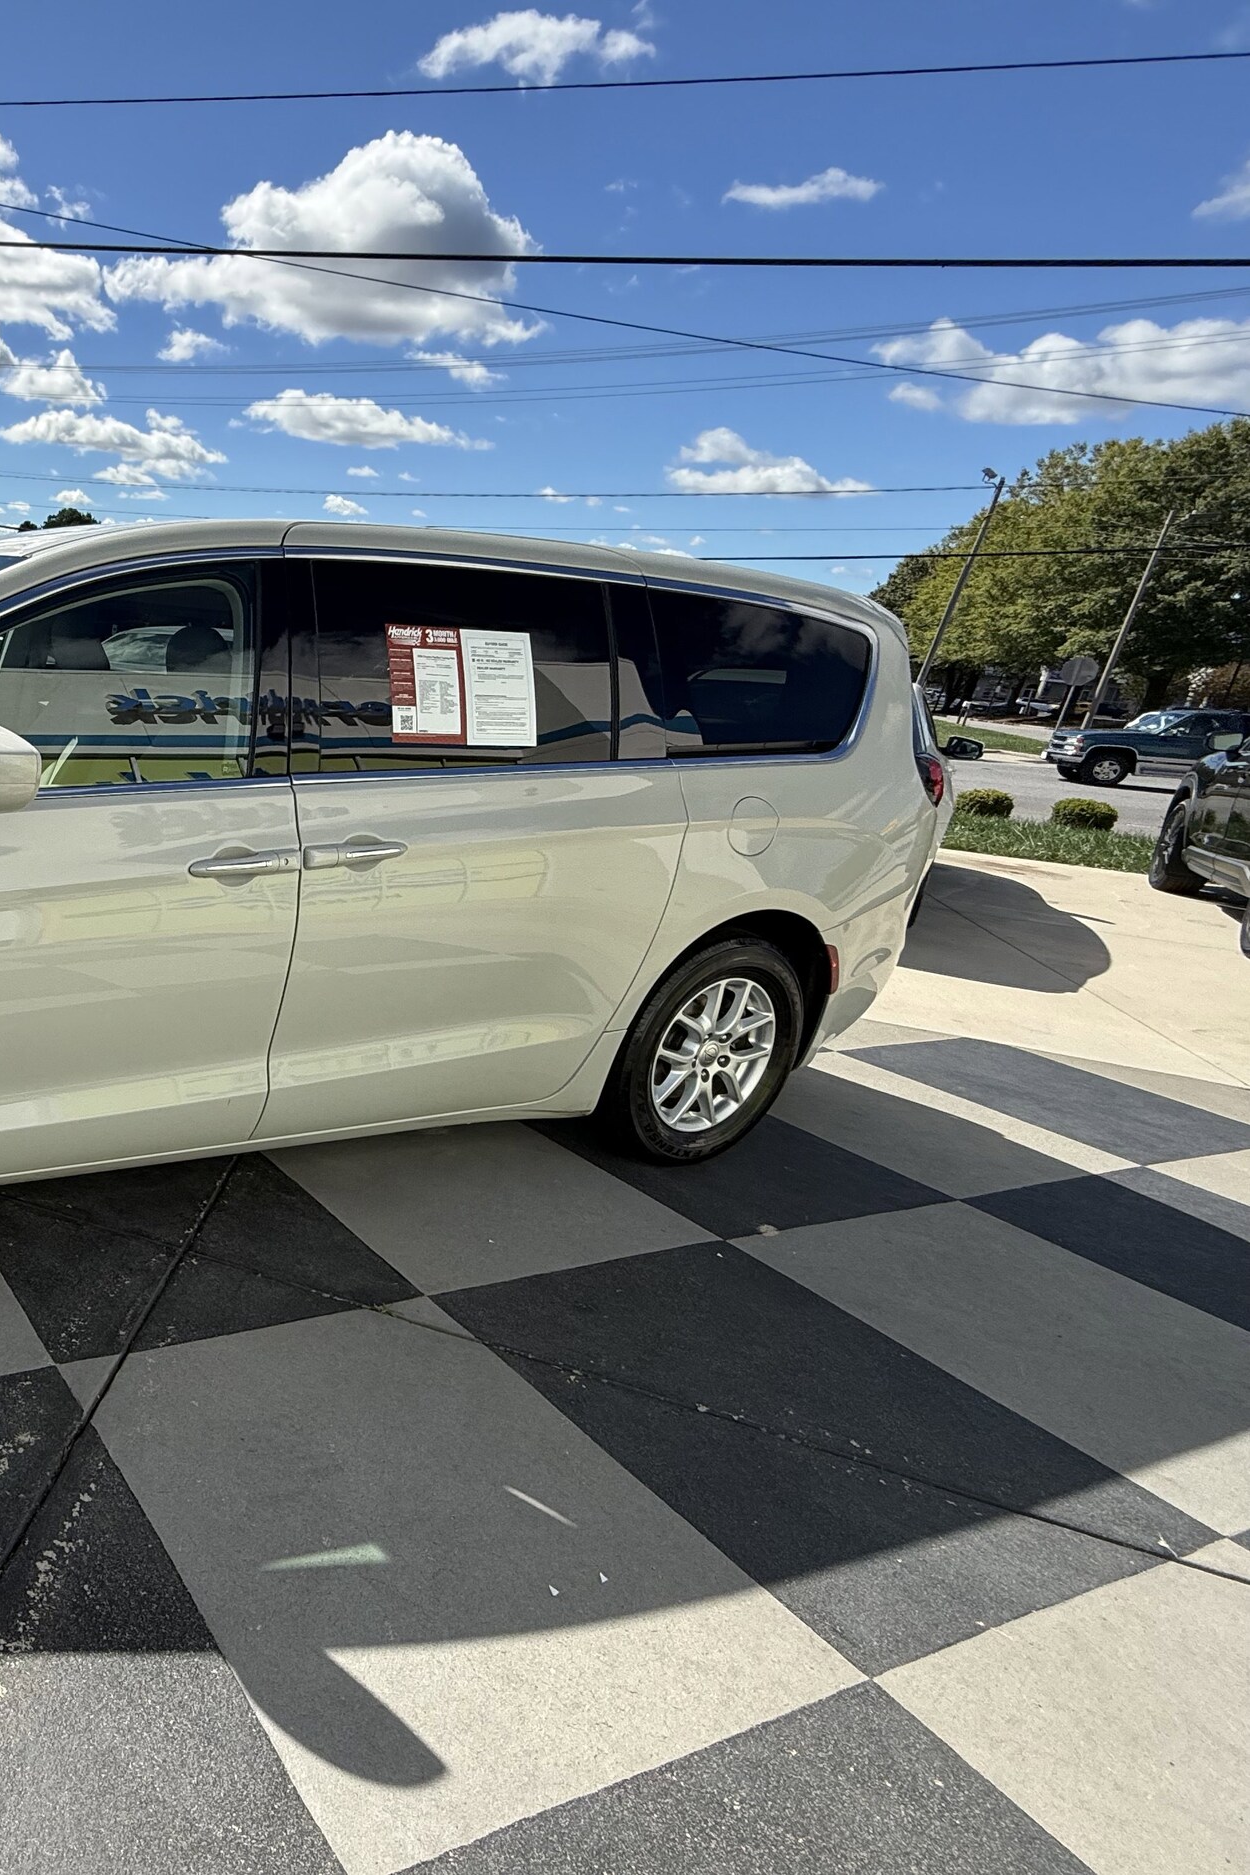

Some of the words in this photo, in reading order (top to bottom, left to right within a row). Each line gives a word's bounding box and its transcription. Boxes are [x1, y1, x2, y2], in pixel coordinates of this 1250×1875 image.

[388, 626, 422, 638] Hendrick
[425, 629, 434, 643] 3
[643, 1122, 703, 1158] EXTENSA
